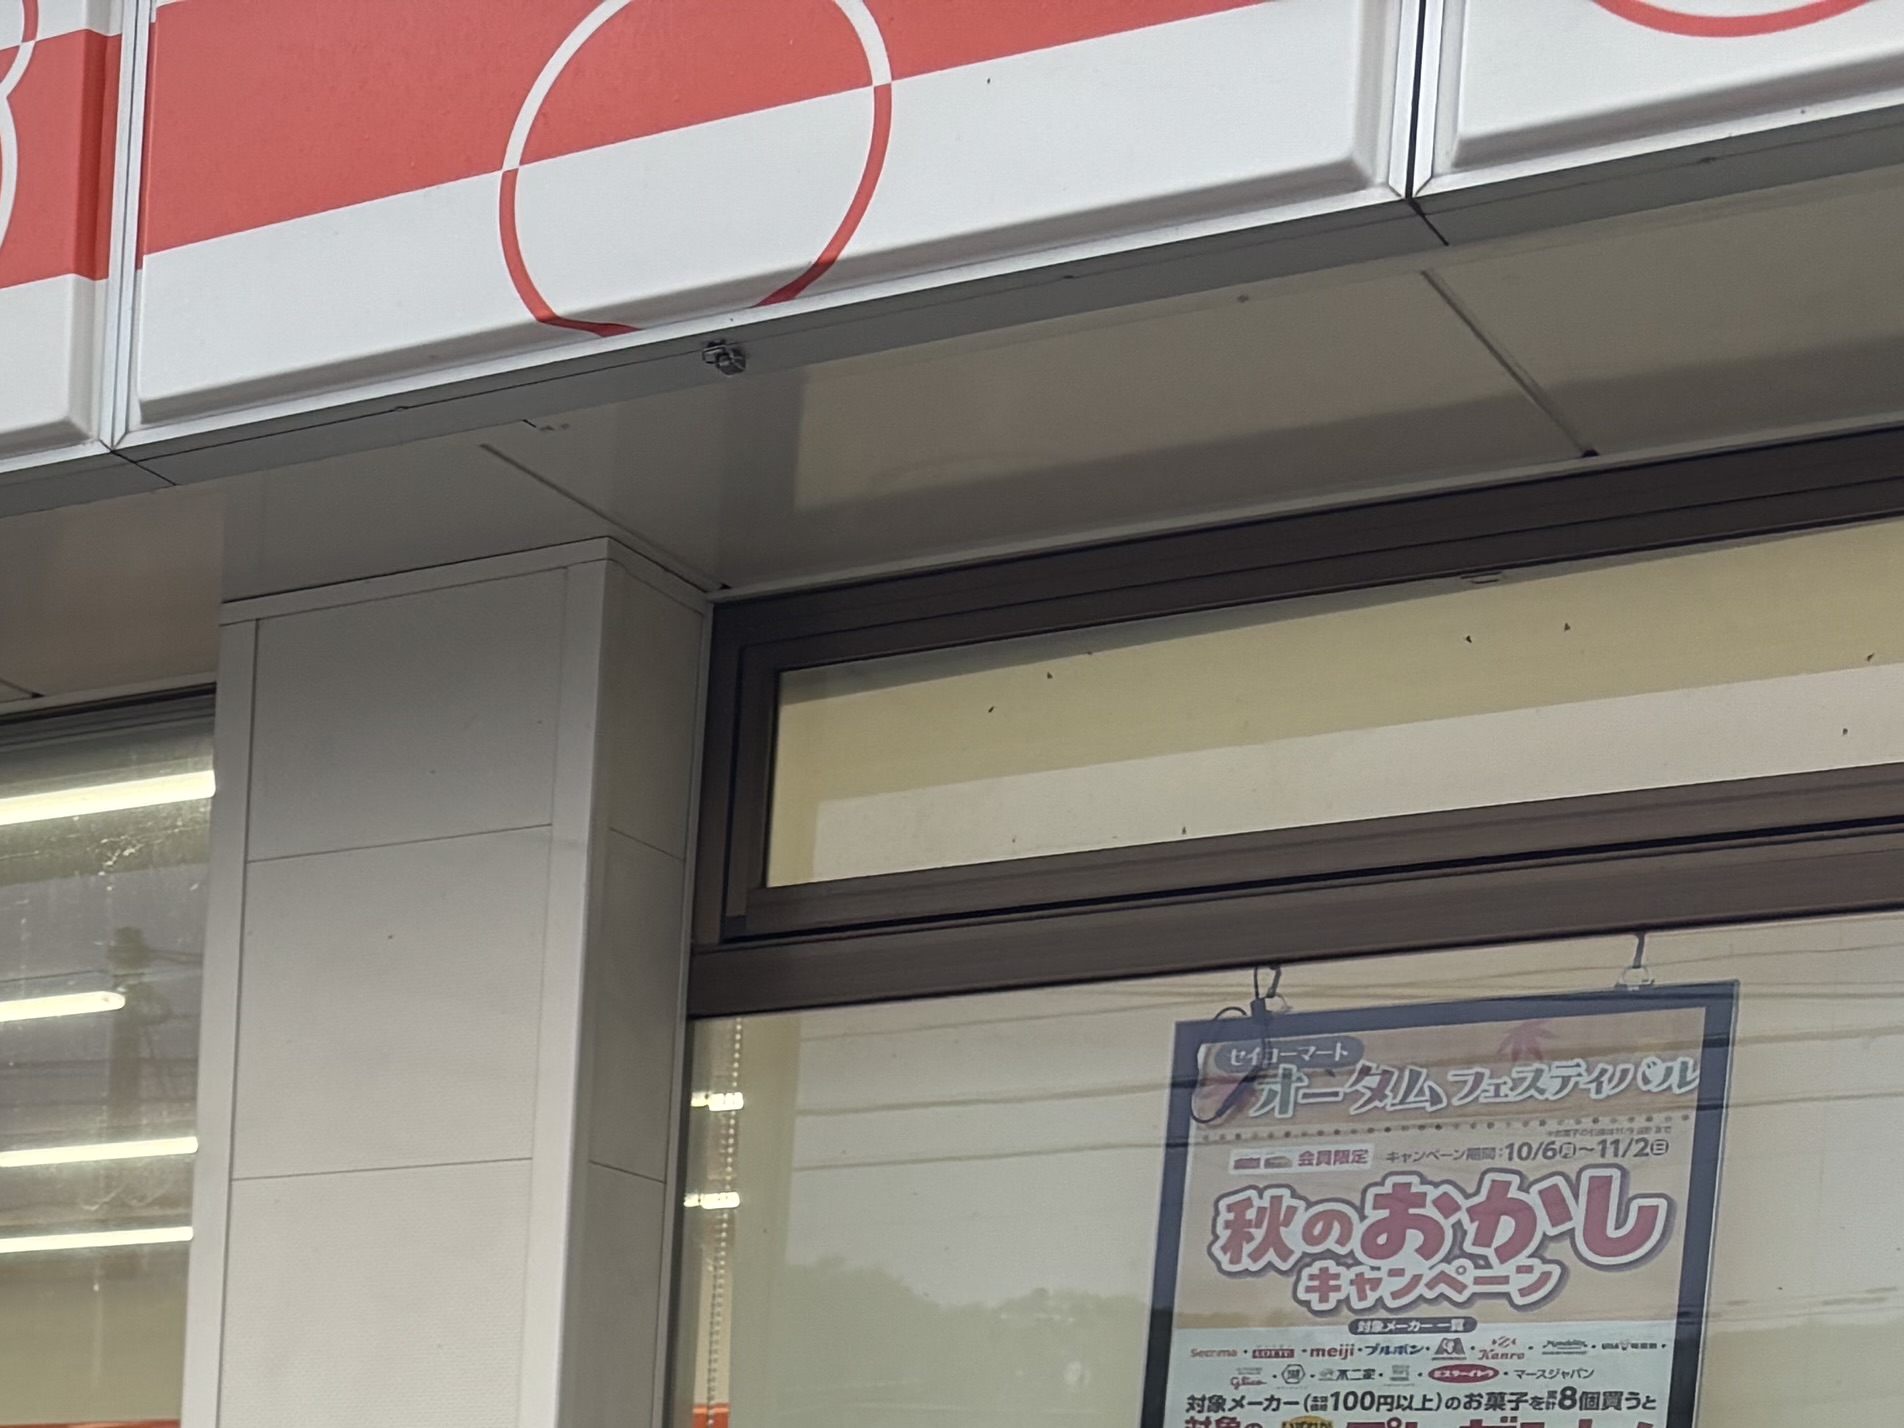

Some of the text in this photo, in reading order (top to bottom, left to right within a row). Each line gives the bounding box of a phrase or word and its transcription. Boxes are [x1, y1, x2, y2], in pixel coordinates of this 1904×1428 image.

[1297, 1151, 1368, 1168] 会員限定
[1219, 1168, 1667, 1272] 秋のおかし
[1299, 1262, 1558, 1307] キャンペーン
[1310, 1343, 1354, 1361] meiji
